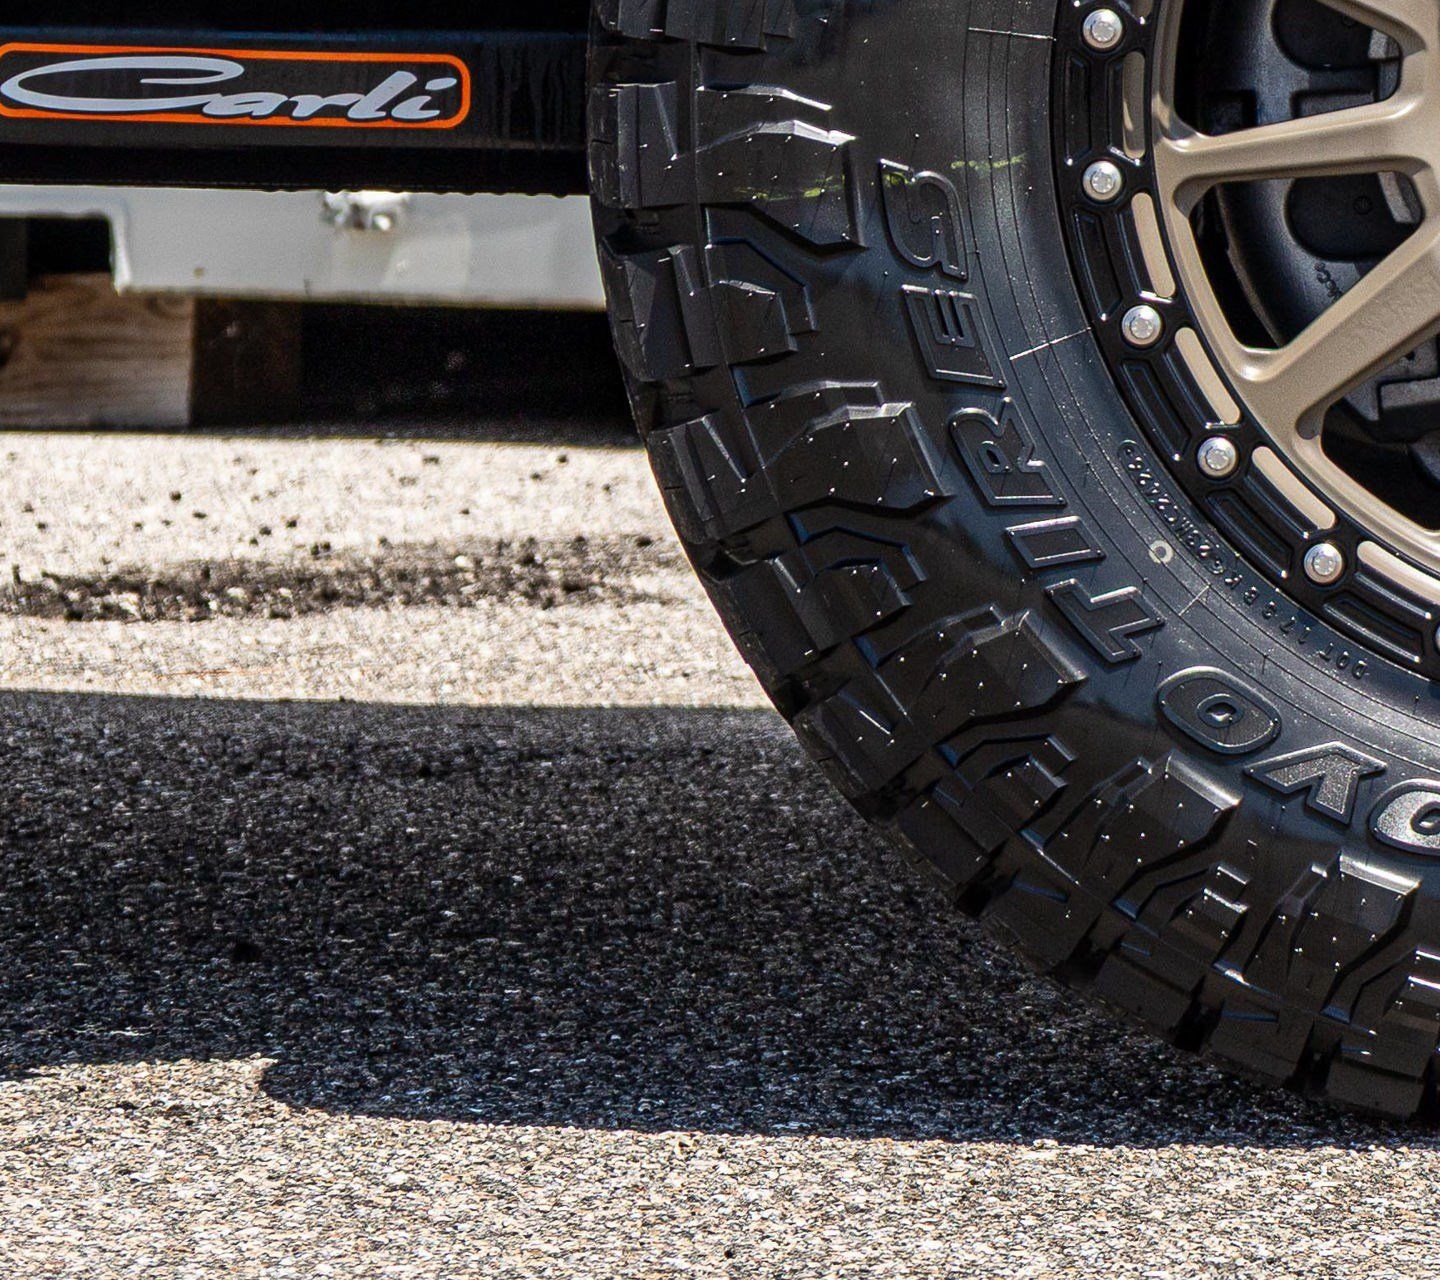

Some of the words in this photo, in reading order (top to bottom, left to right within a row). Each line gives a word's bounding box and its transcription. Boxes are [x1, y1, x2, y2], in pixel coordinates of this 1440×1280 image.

[0, 54, 458, 120] Carli
[884, 165, 1166, 666] TIRES
[1317, 641, 1369, 680] DOT
